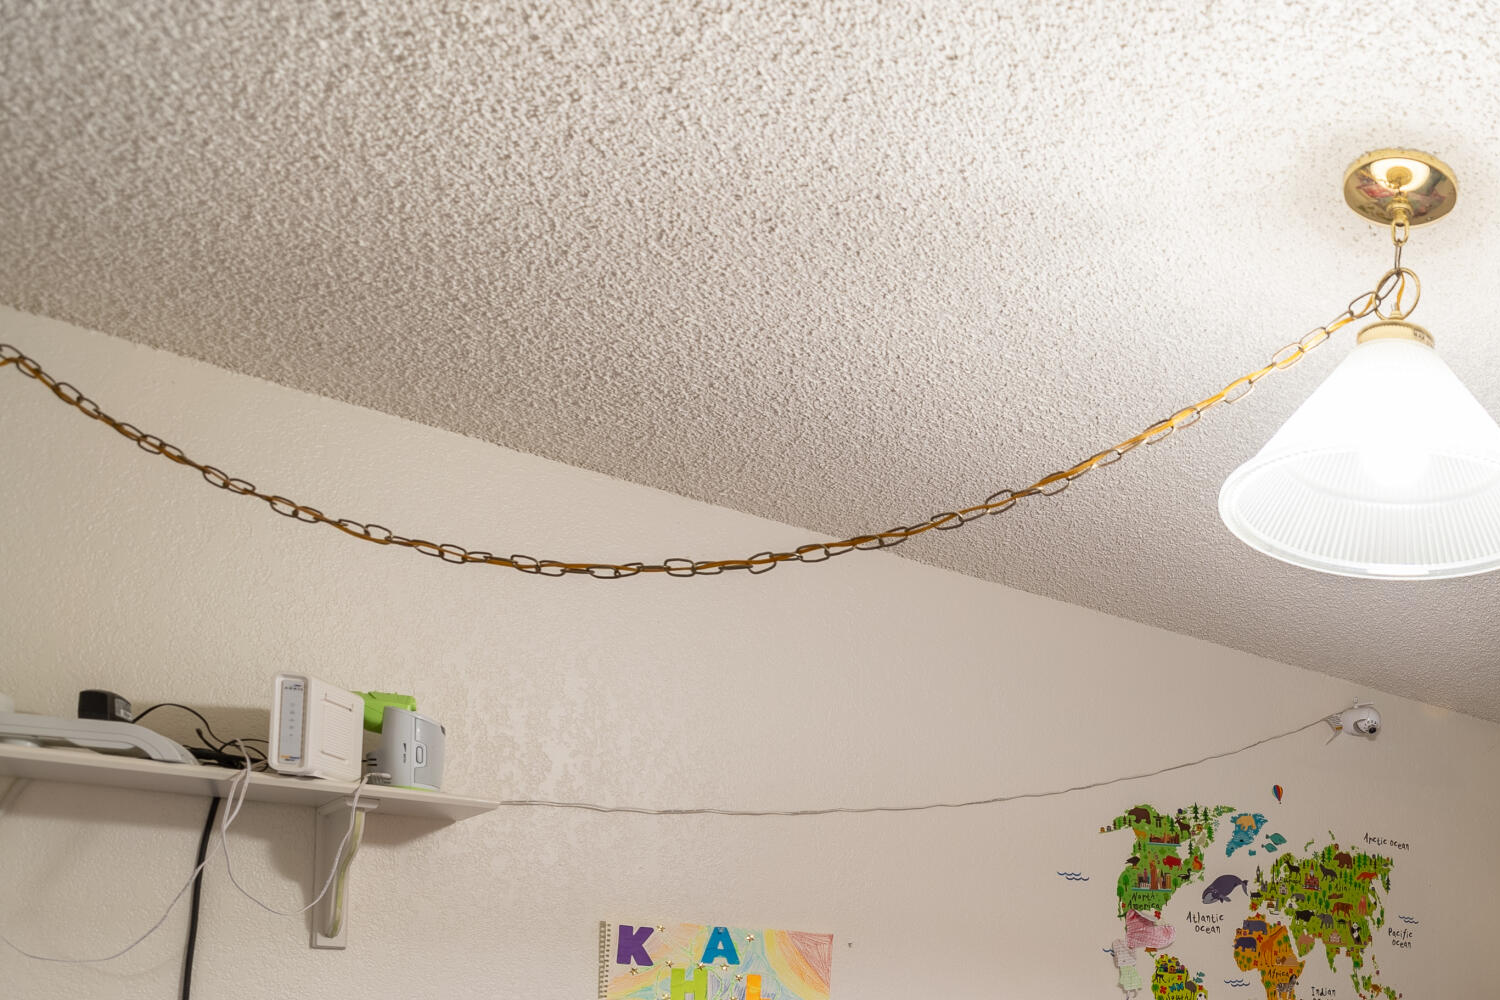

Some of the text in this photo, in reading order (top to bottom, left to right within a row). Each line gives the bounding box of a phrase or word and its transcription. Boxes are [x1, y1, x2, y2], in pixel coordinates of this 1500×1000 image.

[1128, 900, 1159, 910] America
[1186, 912, 1224, 923] Atlantic
[1388, 928, 1413, 940] Pacific
[1268, 968, 1289, 979] Africa
[1311, 986, 1336, 997] Indian
